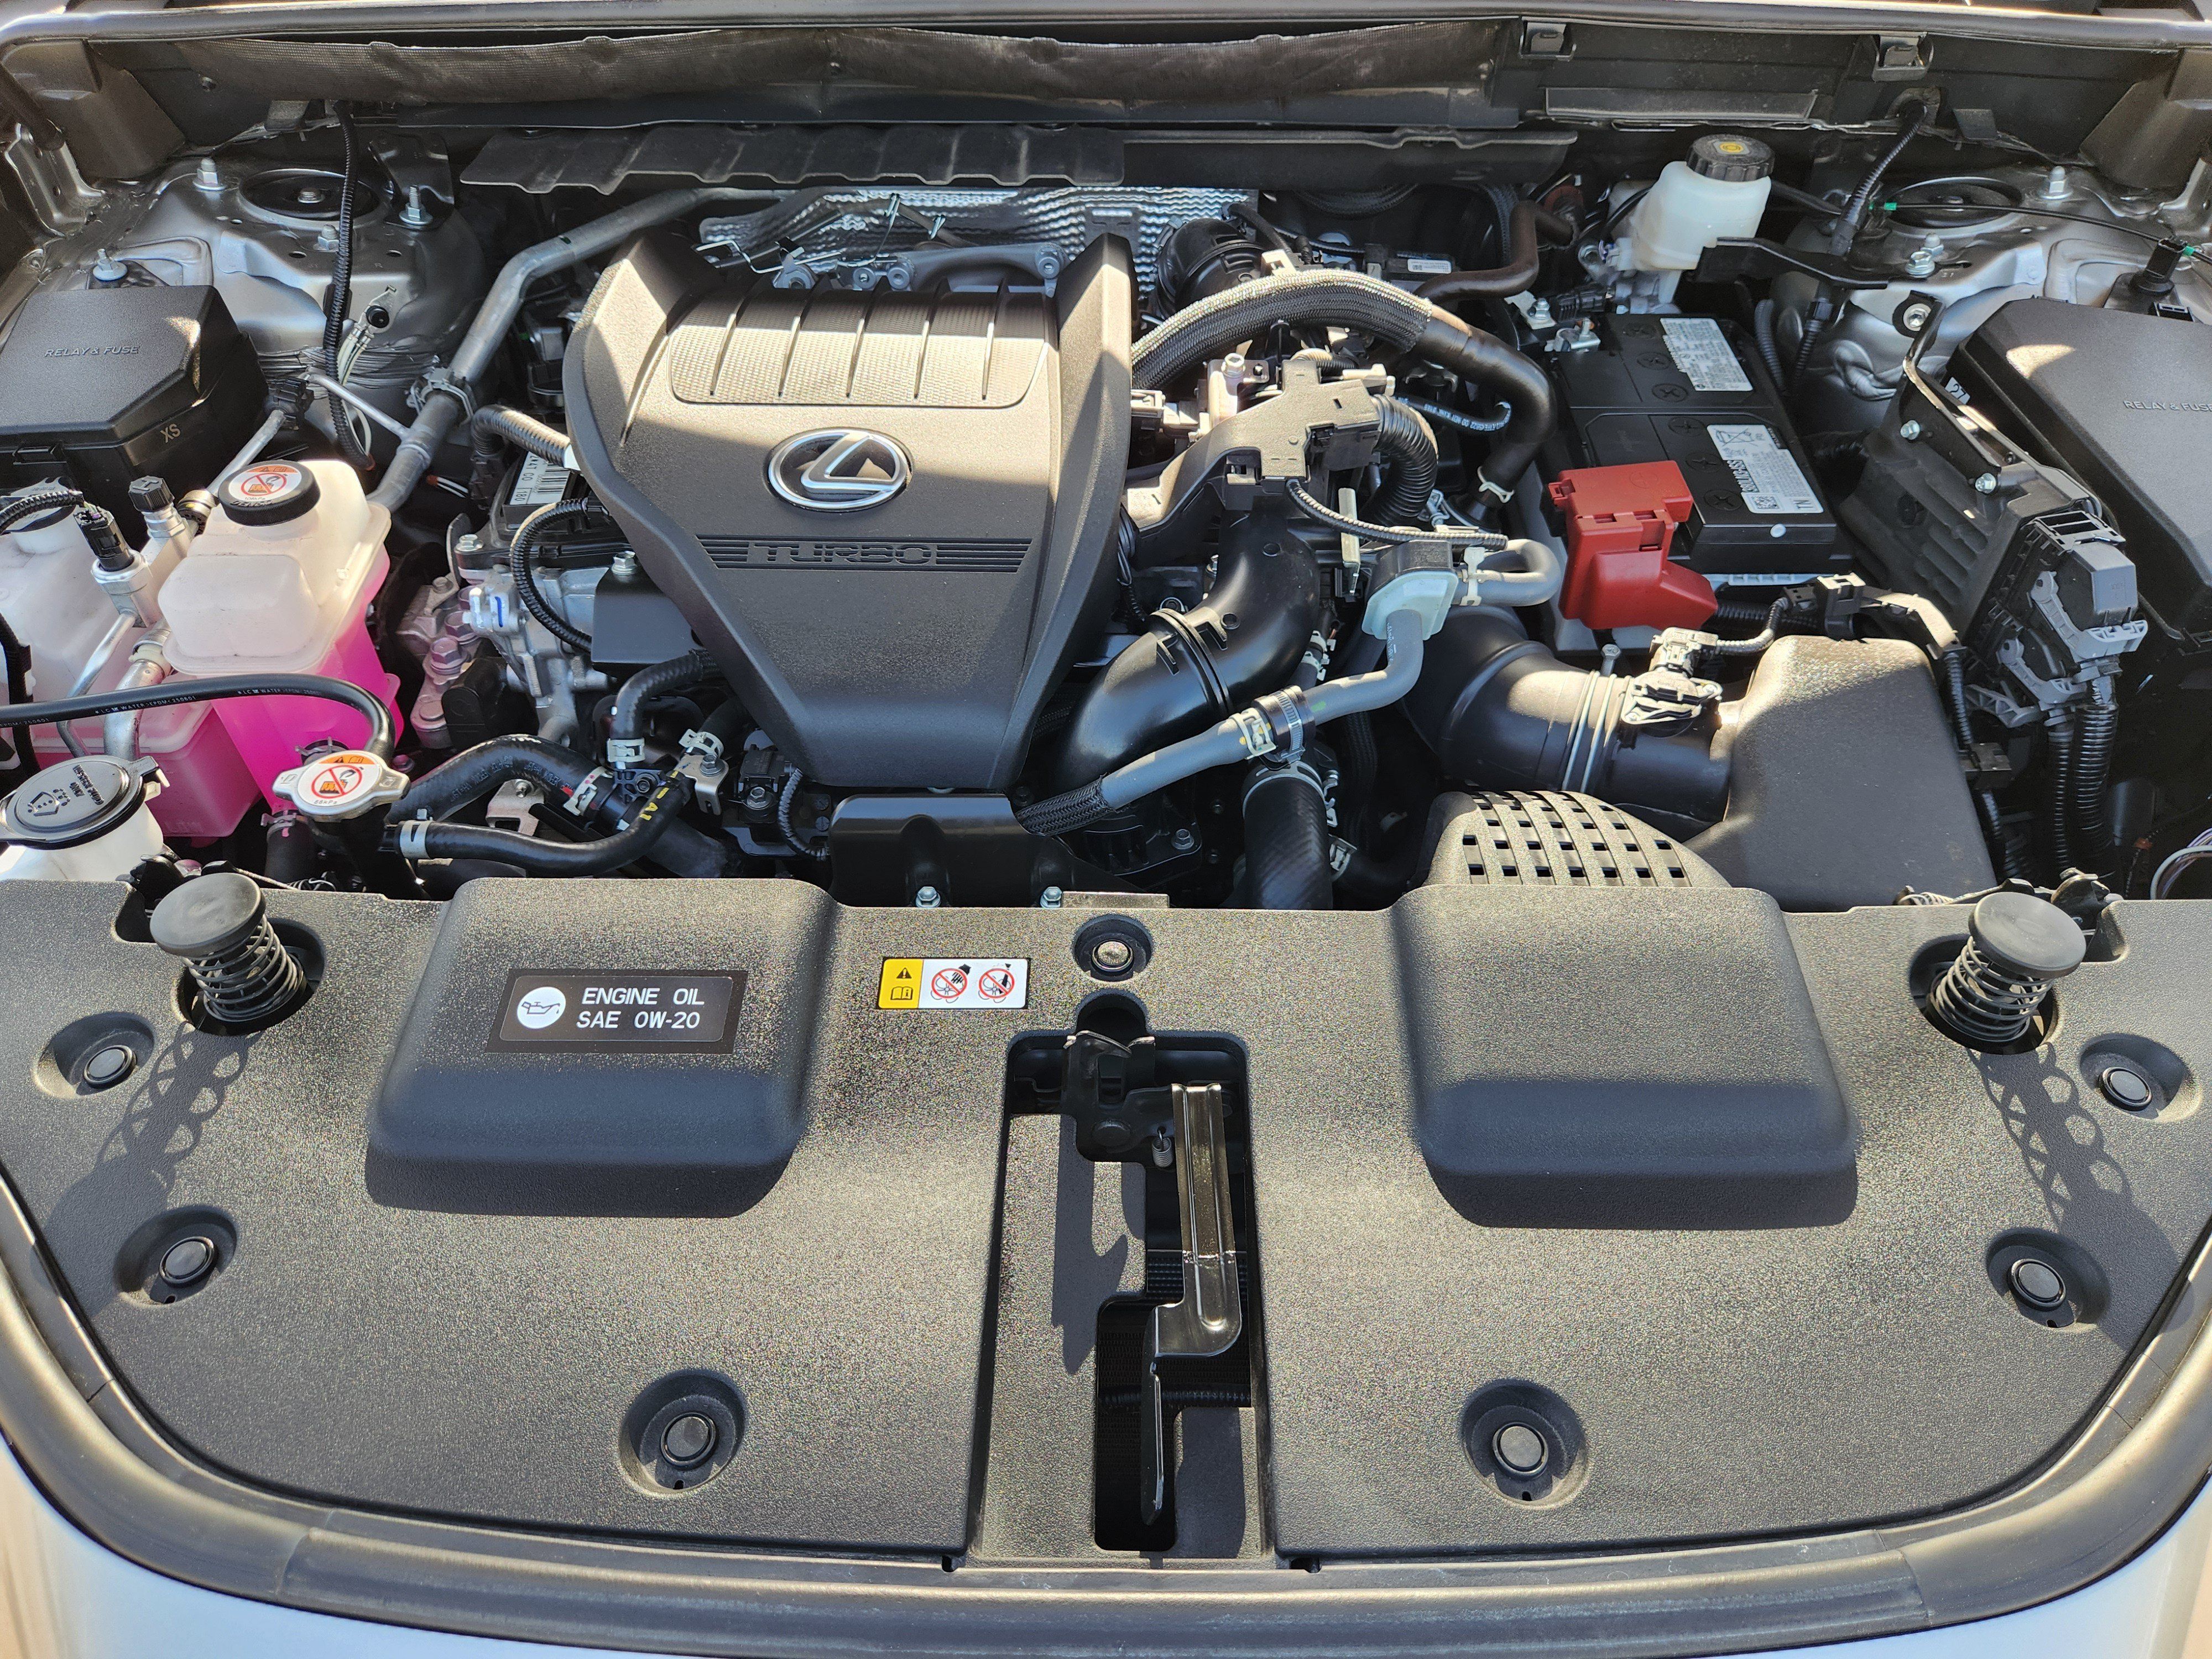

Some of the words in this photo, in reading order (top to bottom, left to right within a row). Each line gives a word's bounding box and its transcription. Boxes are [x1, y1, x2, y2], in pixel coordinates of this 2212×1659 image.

[44, 347, 91, 357] RELAY
[90, 347, 100, 355] &
[103, 346, 139, 355] FUSE
[1950, 383, 1966, 399] 27
[2123, 400, 2167, 410] RELAY
[2169, 403, 2179, 411] &
[160, 423, 181, 443] XS
[515, 491, 528, 502] 180
[753, 542, 932, 565] TURBO
[581, 987, 660, 1005] ENGINE
[672, 988, 705, 1005] OIL
[576, 1011, 622, 1029] SAE
[634, 1011, 701, 1029] 0W-20
